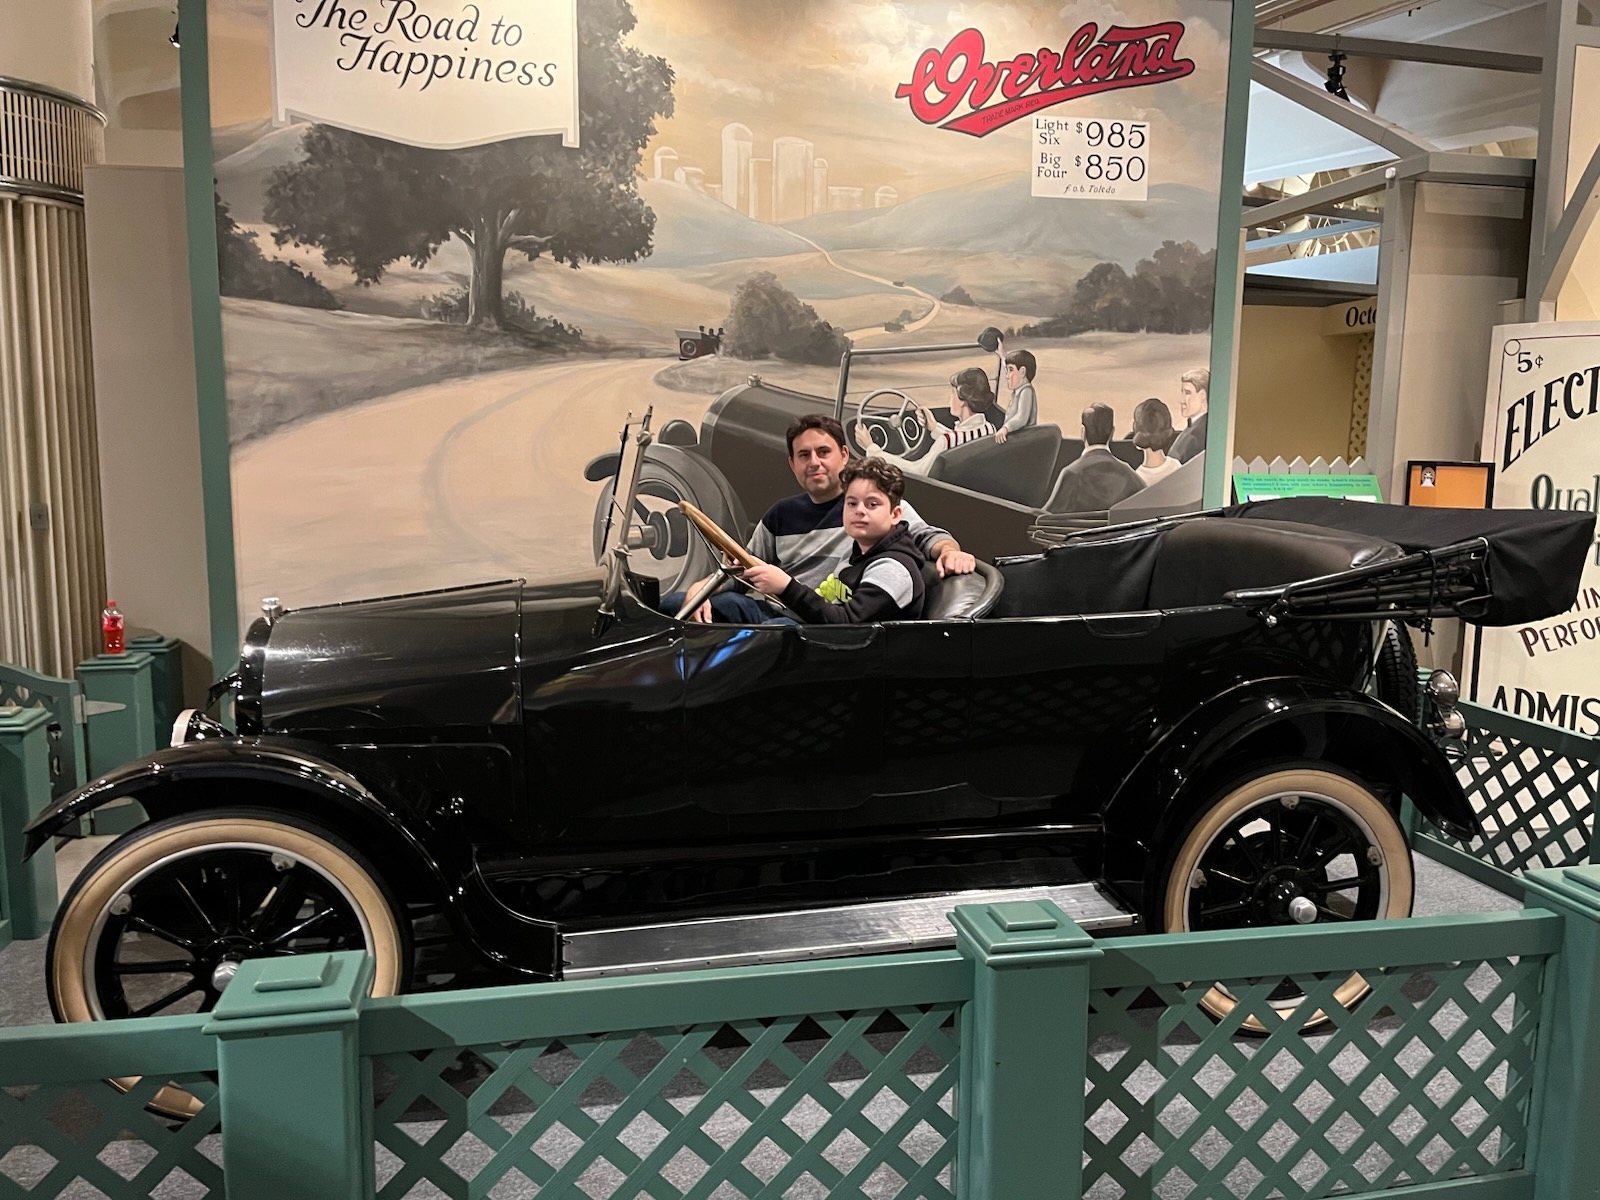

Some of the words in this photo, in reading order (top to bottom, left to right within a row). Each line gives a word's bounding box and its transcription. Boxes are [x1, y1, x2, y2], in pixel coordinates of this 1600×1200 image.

[295, 0, 367, 31] The
[373, 0, 480, 43] Road
[490, 15, 523, 46] to
[336, 33, 557, 91] Happiness
[895, 22, 1196, 124] Overland
[1036, 118, 1069, 135] Light
[1075, 121, 1147, 149] $985
[1039, 132, 1060, 145] Six
[1037, 166, 1068, 178] Four
[1040, 152, 1061, 169] Big
[1074, 154, 1146, 182] $850
[1088, 184, 1116, 194] Toledo
